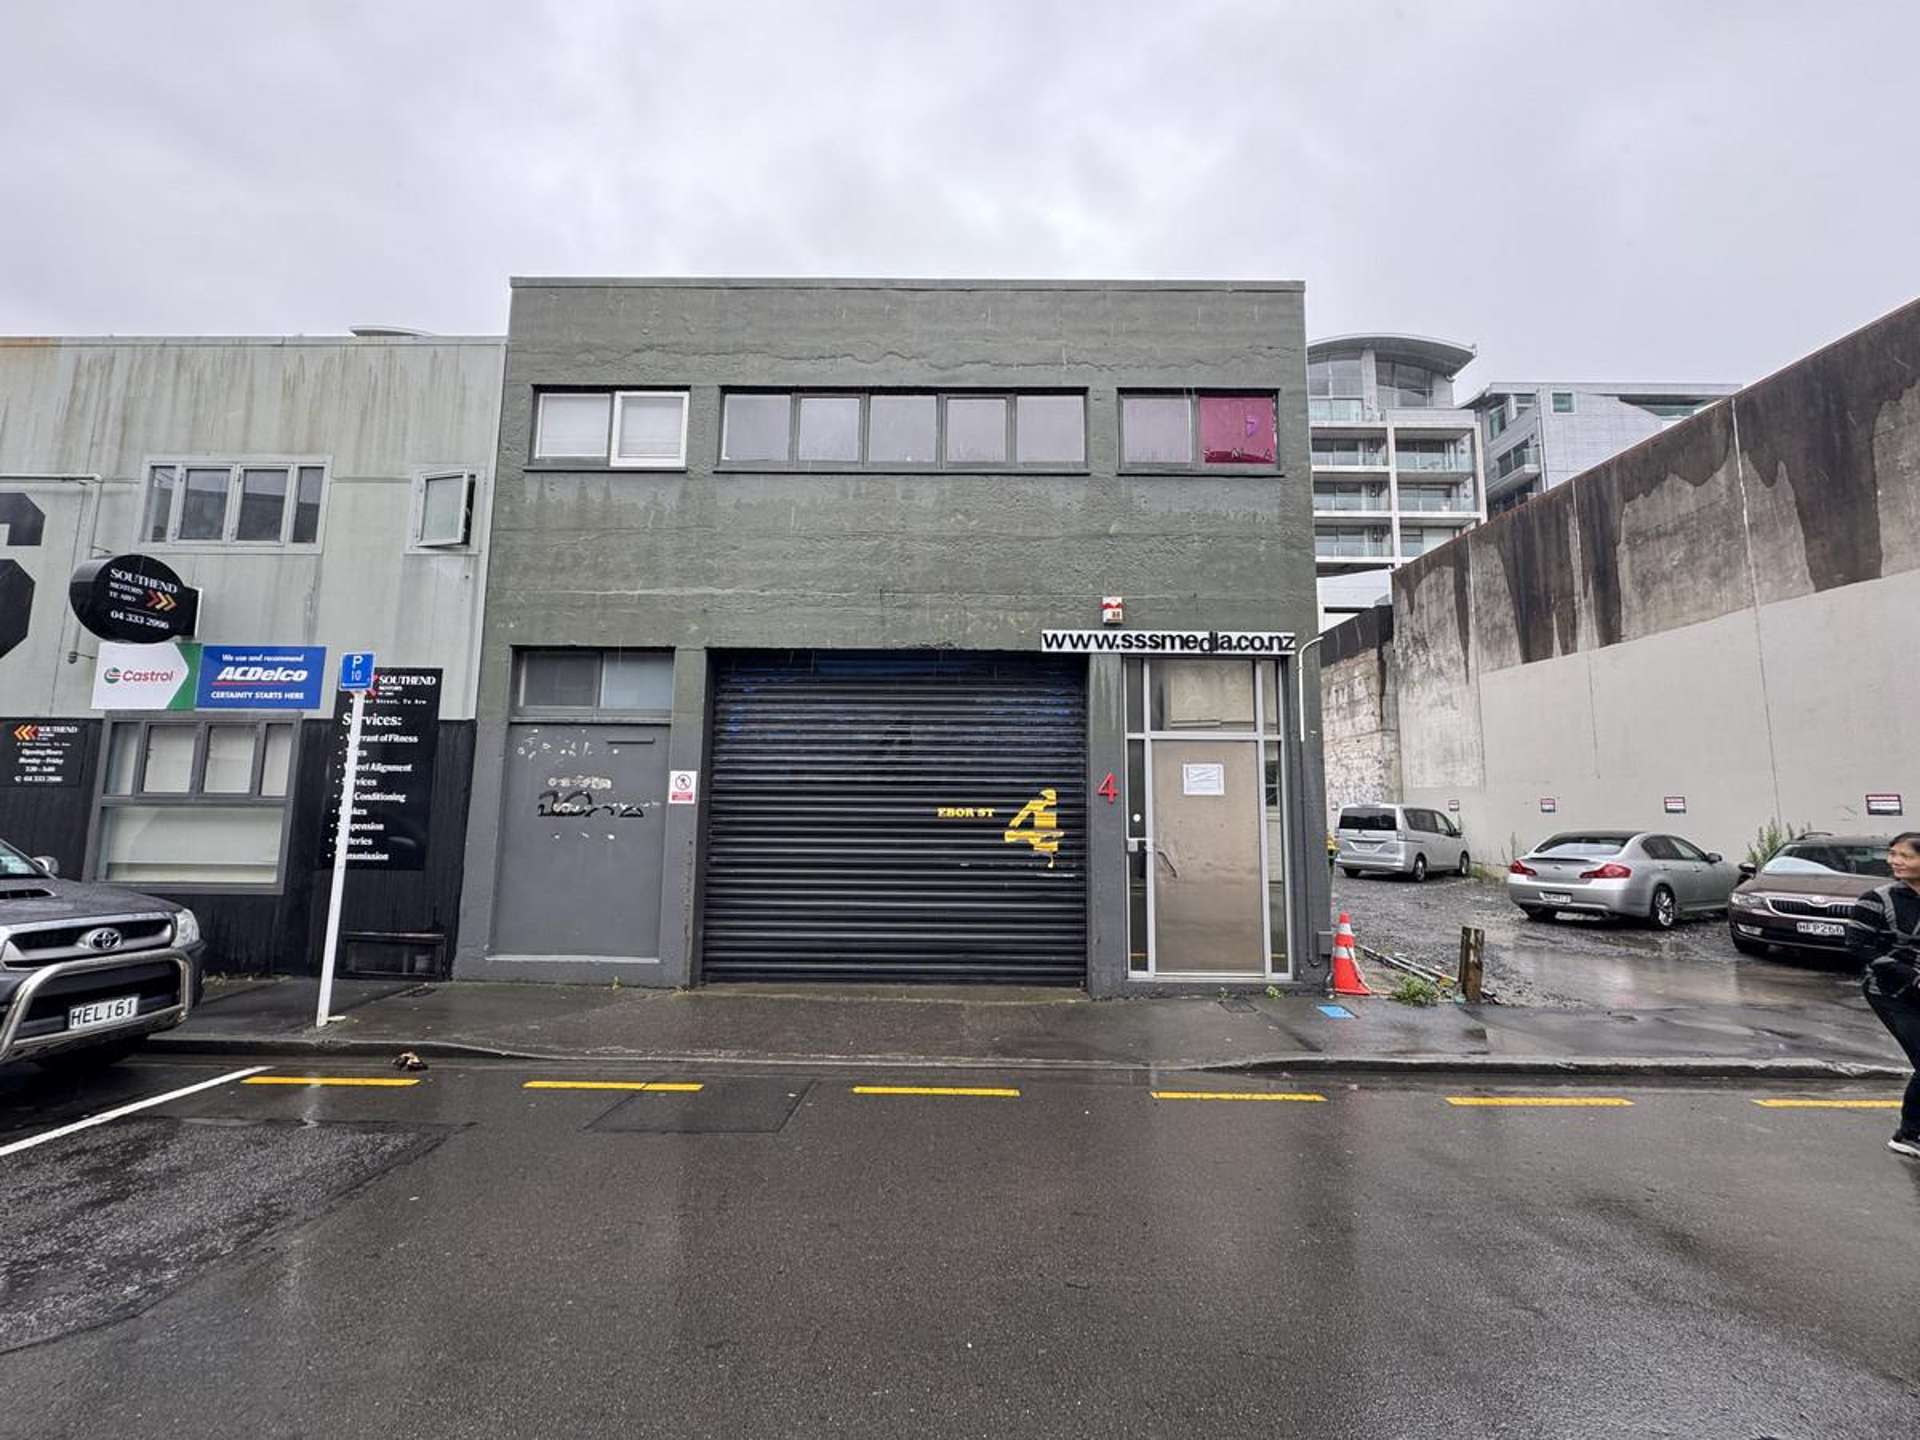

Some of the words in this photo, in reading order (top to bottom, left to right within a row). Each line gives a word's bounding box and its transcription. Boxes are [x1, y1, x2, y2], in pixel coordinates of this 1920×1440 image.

[110, 568, 177, 593] SOUTHEND
[1042, 630, 1296, 653] www.sssmedia.co.nz
[222, 653, 234, 661] We
[248, 653, 263, 661] and
[264, 654, 304, 662] recommend
[352, 655, 364, 669] P
[122, 670, 175, 686] Castrol
[216, 666, 308, 682] ACDelco
[351, 669, 362, 681] 10
[379, 675, 437, 686] SOUTHEND
[211, 690, 254, 699] CERTAINTY
[255, 691, 283, 699] STARTS
[284, 692, 305, 700] HERE
[342, 712, 403, 726] Srvices:
[1097, 772, 1120, 805] 4
[937, 807, 975, 818] EBOR
[977, 807, 995, 818] ST
[1003, 788, 1065, 858] 4
[71, 1000, 134, 1027] HEL161
